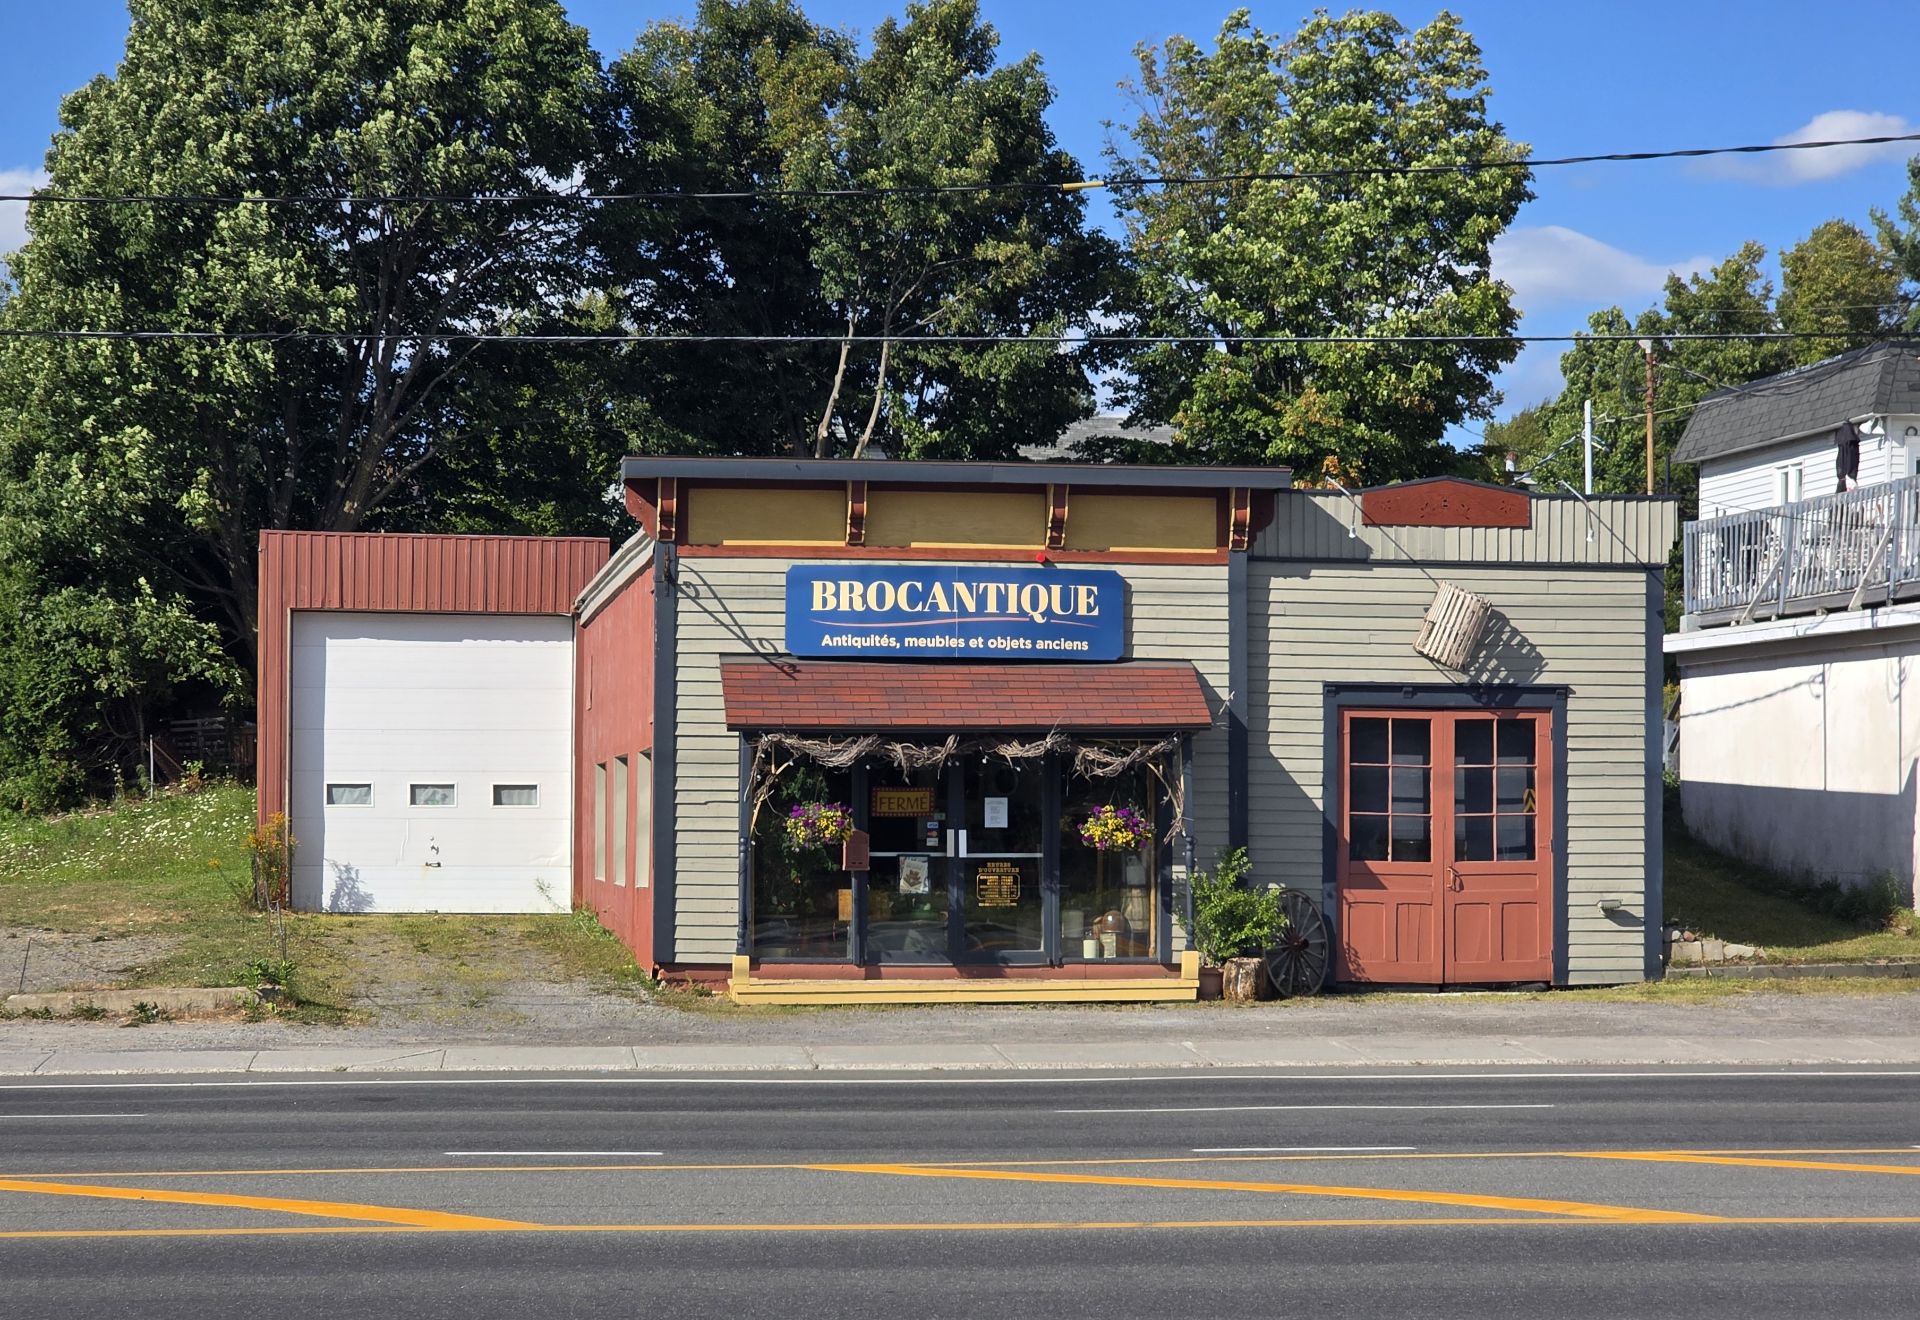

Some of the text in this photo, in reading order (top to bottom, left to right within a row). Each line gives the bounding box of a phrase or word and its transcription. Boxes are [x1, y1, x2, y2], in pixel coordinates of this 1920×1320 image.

[811, 580, 1099, 623] BROCANTIQUE
[821, 634, 1089, 650] Antiquités, meubles et objets anciens
[879, 793, 928, 811] FERMÉ
